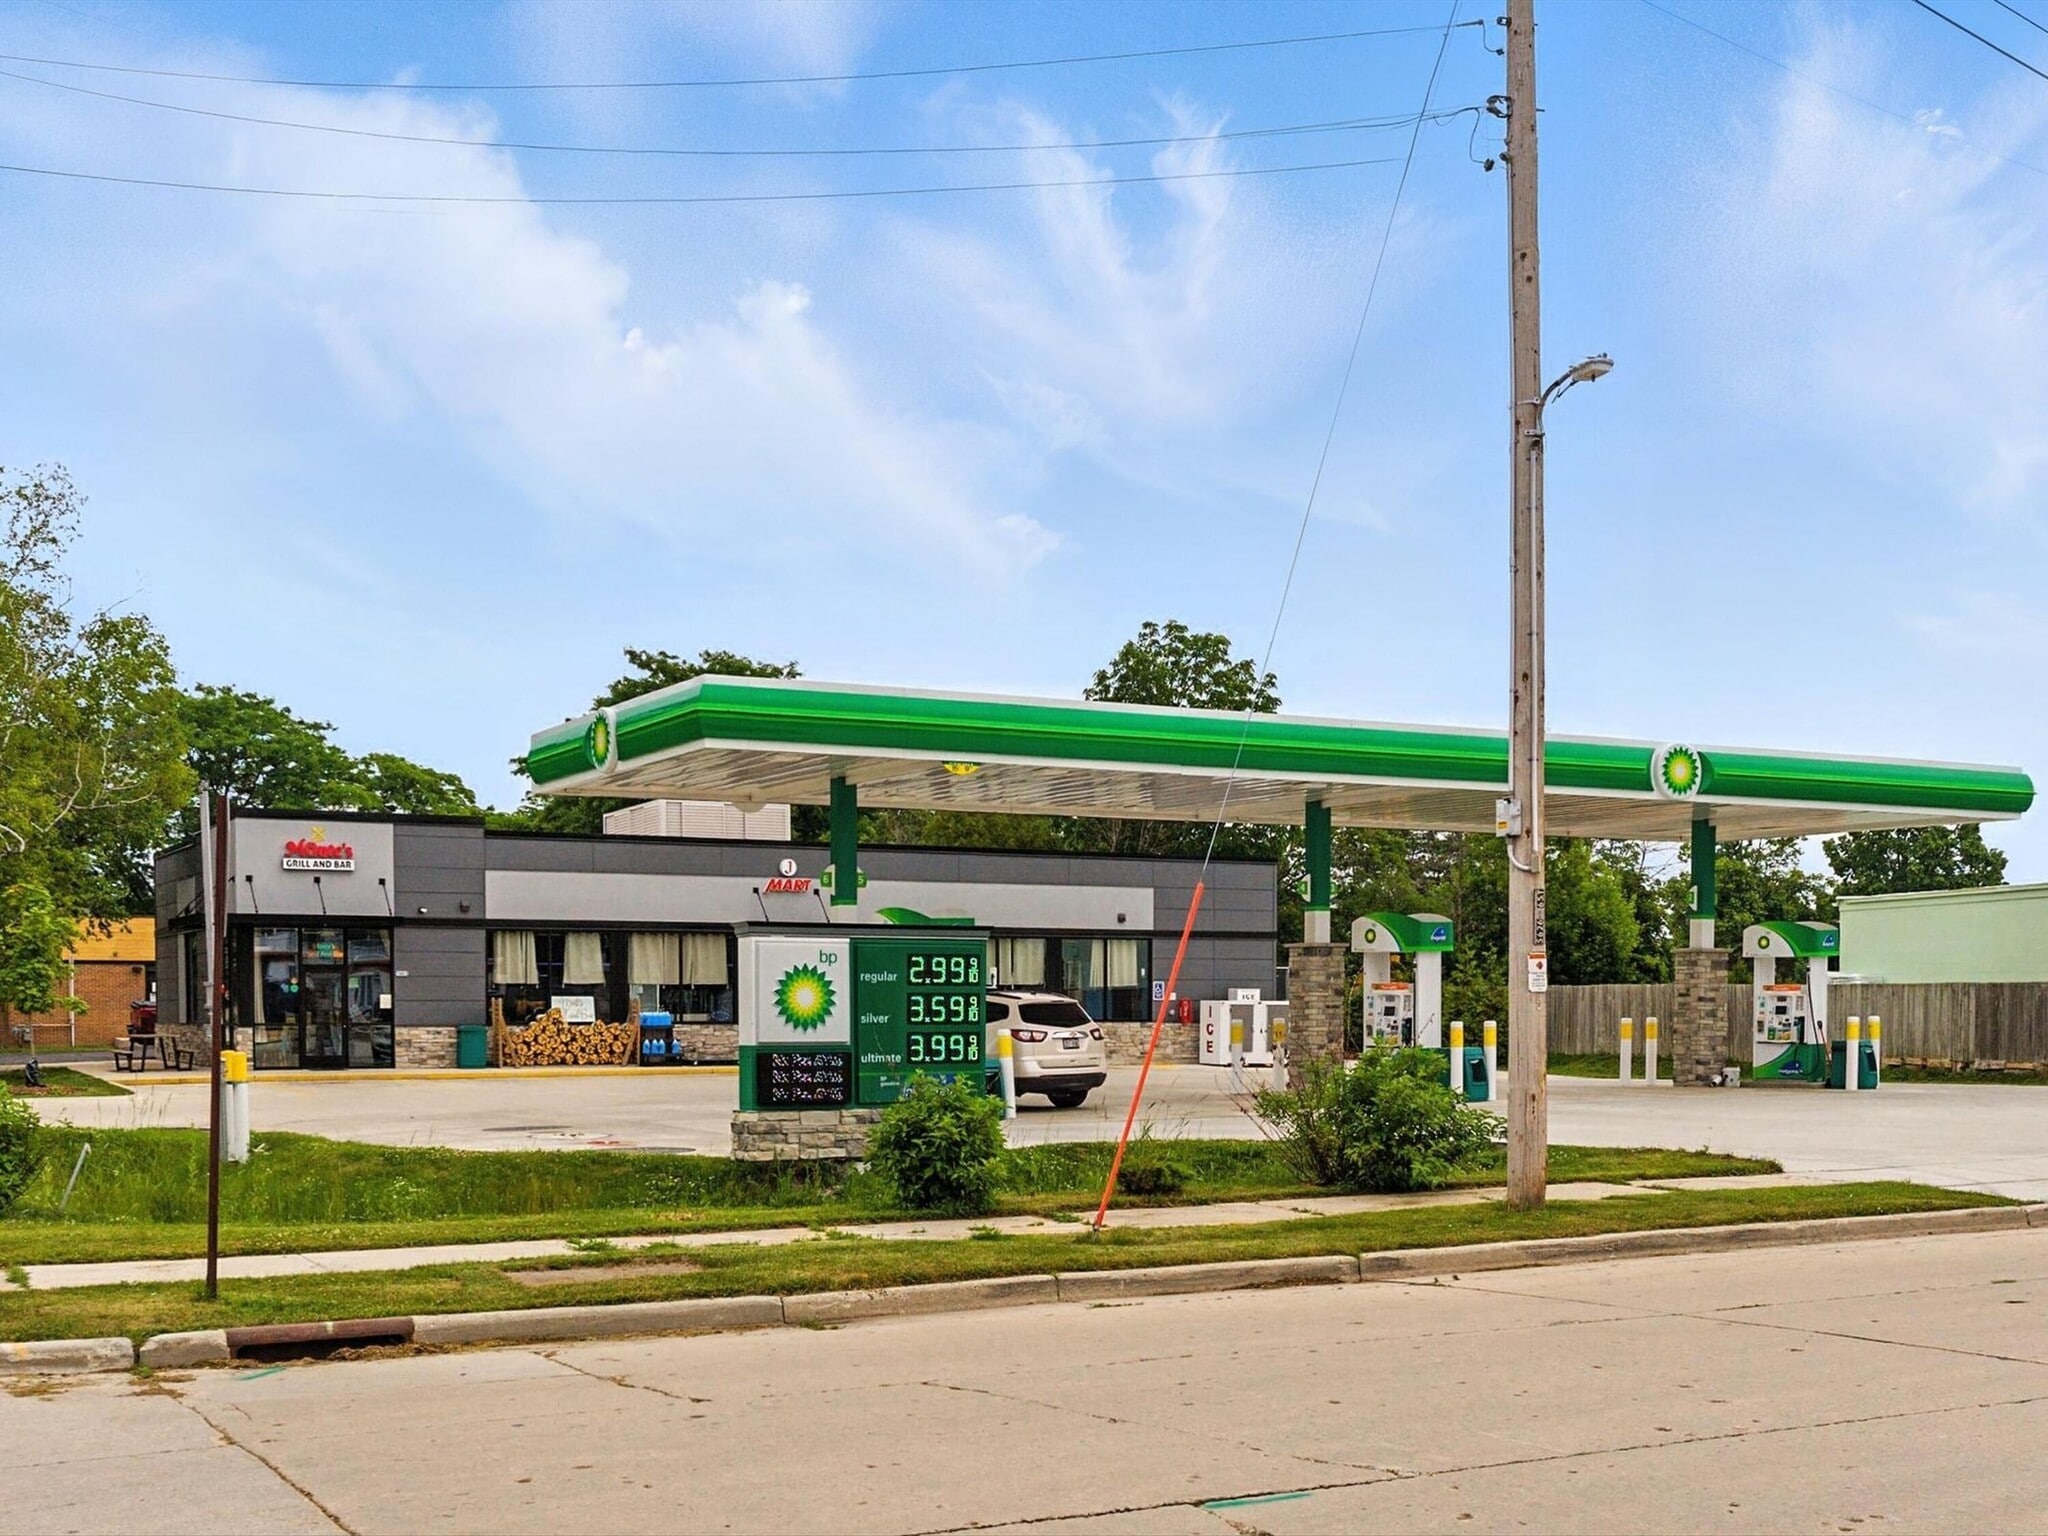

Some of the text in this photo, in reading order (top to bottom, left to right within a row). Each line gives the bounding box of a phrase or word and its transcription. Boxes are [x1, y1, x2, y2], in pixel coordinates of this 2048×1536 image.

[286, 859, 351, 869] GRILL AND BAR
[784, 860, 792, 875] J
[763, 878, 812, 895] MART
[819, 950, 838, 966] bp
[859, 971, 898, 984] regular
[860, 1013, 889, 1024] silver
[1206, 1005, 1214, 1054] ICE
[861, 1053, 902, 1063] ultimate
